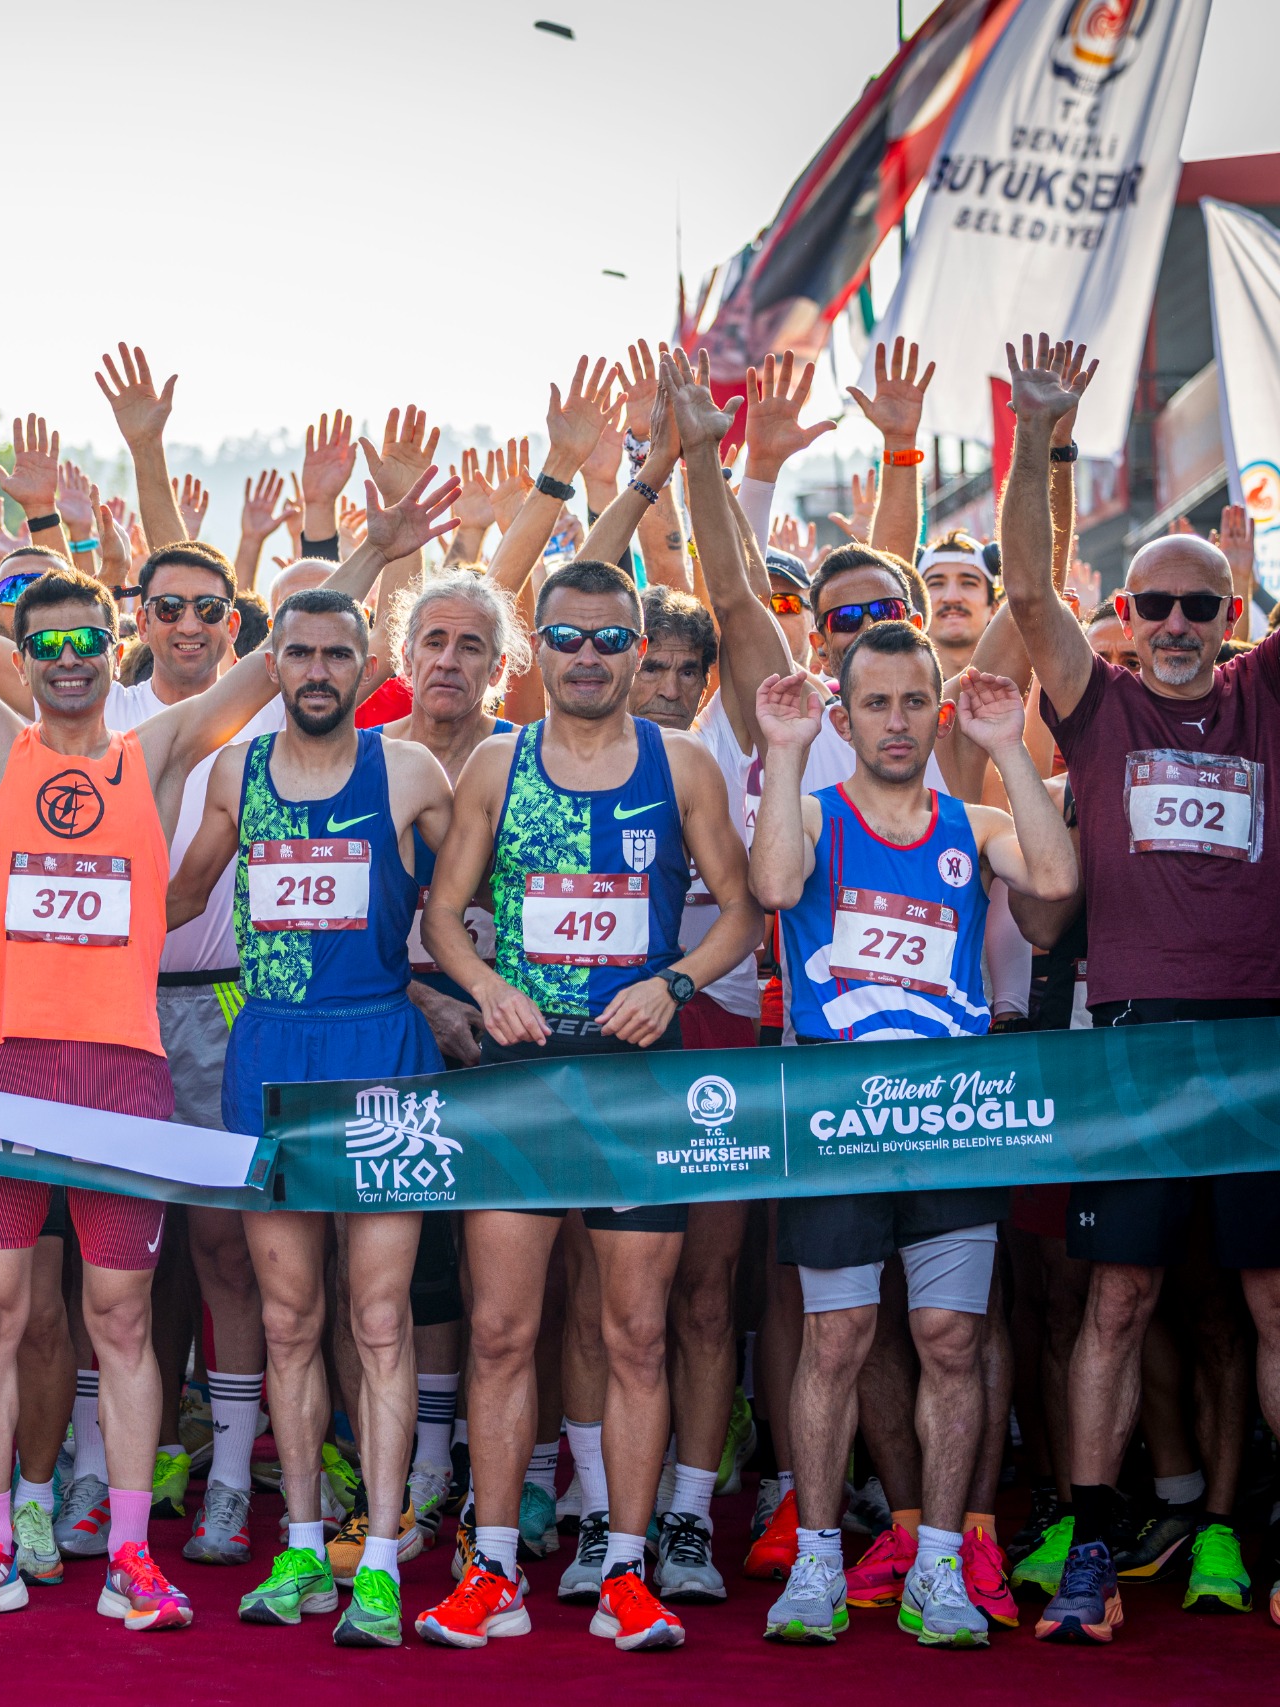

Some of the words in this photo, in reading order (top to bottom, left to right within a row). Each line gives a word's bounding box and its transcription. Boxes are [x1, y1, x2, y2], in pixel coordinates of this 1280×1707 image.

[1199, 771, 1221, 784] 21K
[1153, 797, 1225, 832] 502
[622, 829, 656, 838] ENKA
[311, 846, 334, 857] 21K
[75, 861, 98, 873] 21K
[276, 875, 336, 906] 218
[592, 881, 615, 893] 21K
[32, 888, 102, 921] 370
[906, 904, 928, 919] 21K
[553, 911, 617, 941] 419
[858, 927, 927, 966] 273
[856, 1075, 946, 1108] Bülent
[950, 1070, 1016, 1106] Nuri
[809, 1097, 1055, 1141] ÇAVUŞOĞLU
[705, 1128, 725, 1136] T.C.
[656, 1145, 771, 1165] BÜYÜKŞEHİR
[818, 1145, 836, 1156] T.C.
[838, 1141, 880, 1155] DENİZLİ
[883, 1137, 949, 1152] BÜYÜKŞEHİR
[952, 1135, 1003, 1149] BELEDİYE
[1006, 1133, 1053, 1146] BAŞKANI
[355, 1157, 456, 1190] LYKOS
[356, 1190, 382, 1203] Yarı
[386, 1189, 456, 1202] Maratonu
